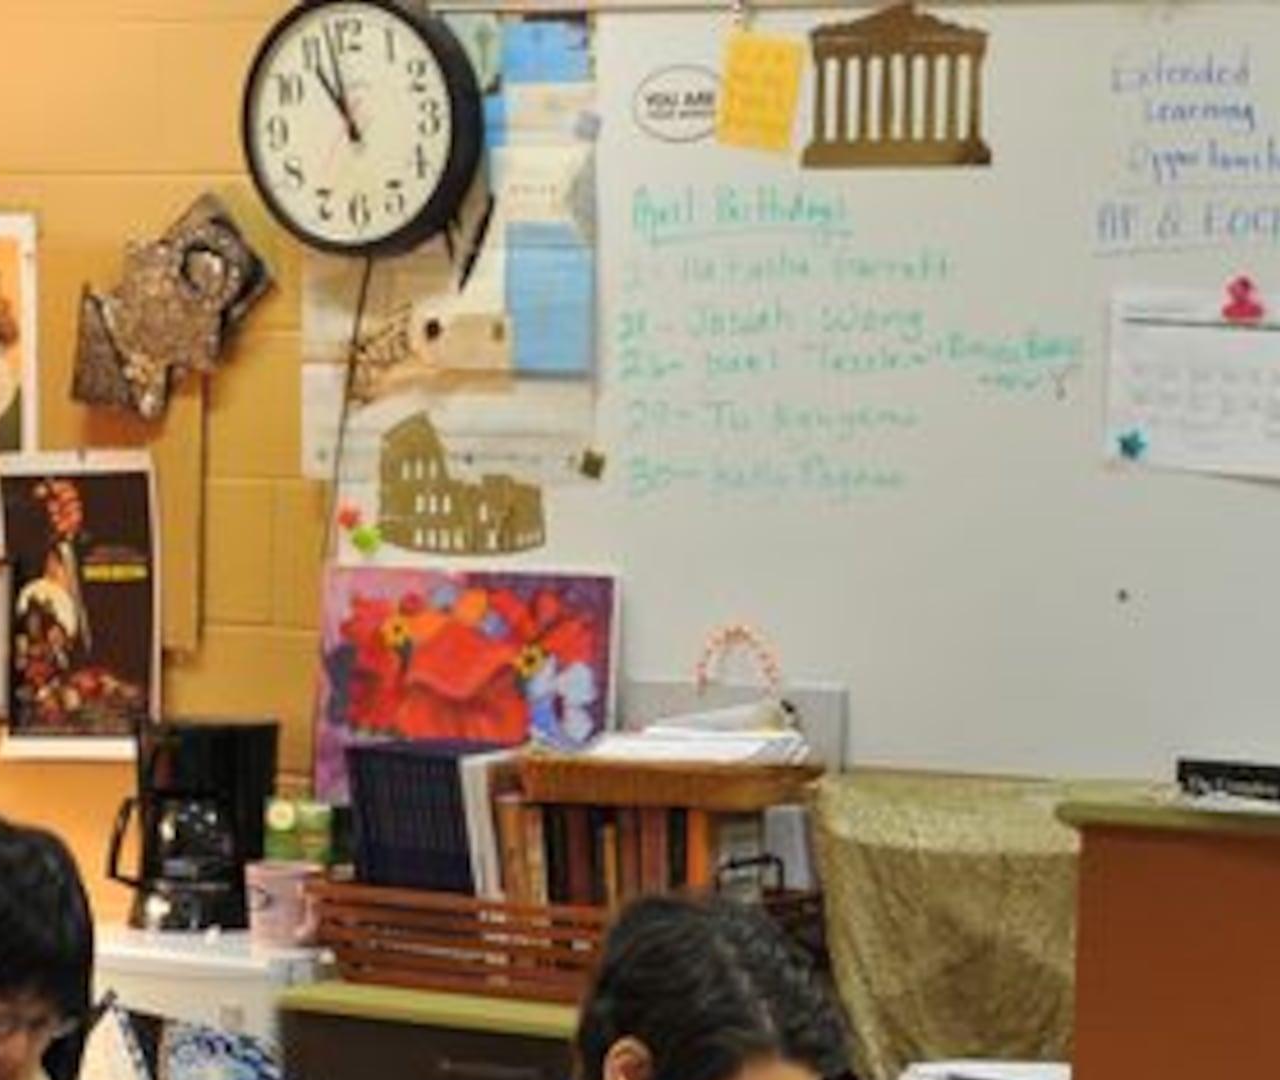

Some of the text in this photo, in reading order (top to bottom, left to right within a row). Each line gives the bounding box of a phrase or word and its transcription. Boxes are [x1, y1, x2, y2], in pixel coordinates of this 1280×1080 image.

[334, 18, 363, 54] 12
[384, 28, 396, 62] 1
[406, 58, 428, 93] 2
[1111, 46, 1251, 92] Extended
[274, 72, 304, 107] 10
[645, 91, 679, 106] YOU
[267, 116, 289, 149] 9
[418, 102, 441, 136] 3
[1144, 97, 1256, 134] Learning
[282, 158, 305, 190] 8
[408, 144, 427, 180] 4
[314, 188, 334, 221] 7
[348, 194, 372, 232] 6
[384, 179, 405, 215] 5
[631, 183, 694, 245] April
